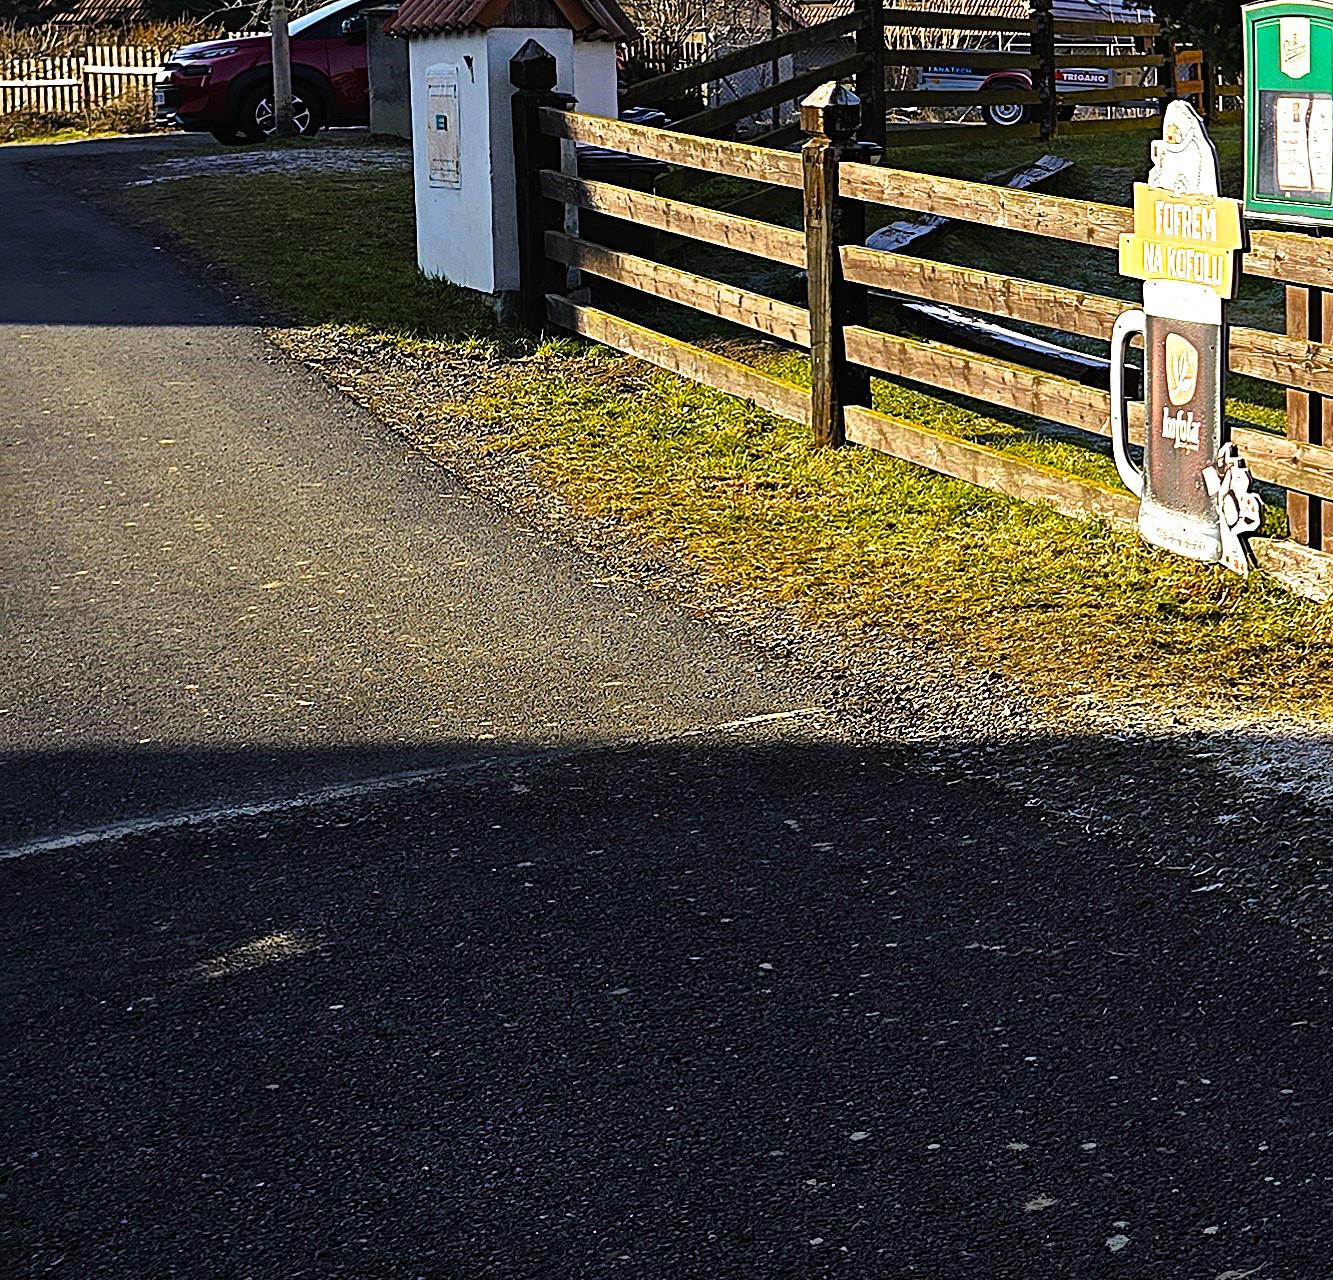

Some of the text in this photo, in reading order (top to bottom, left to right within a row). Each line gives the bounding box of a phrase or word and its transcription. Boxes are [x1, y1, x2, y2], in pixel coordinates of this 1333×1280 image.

[1062, 73, 1106, 82] TRIGANO
[1155, 199, 1217, 241] FOFREM
[1143, 240, 1223, 286] NA KOFOLU
[1162, 406, 1201, 450] kofola
